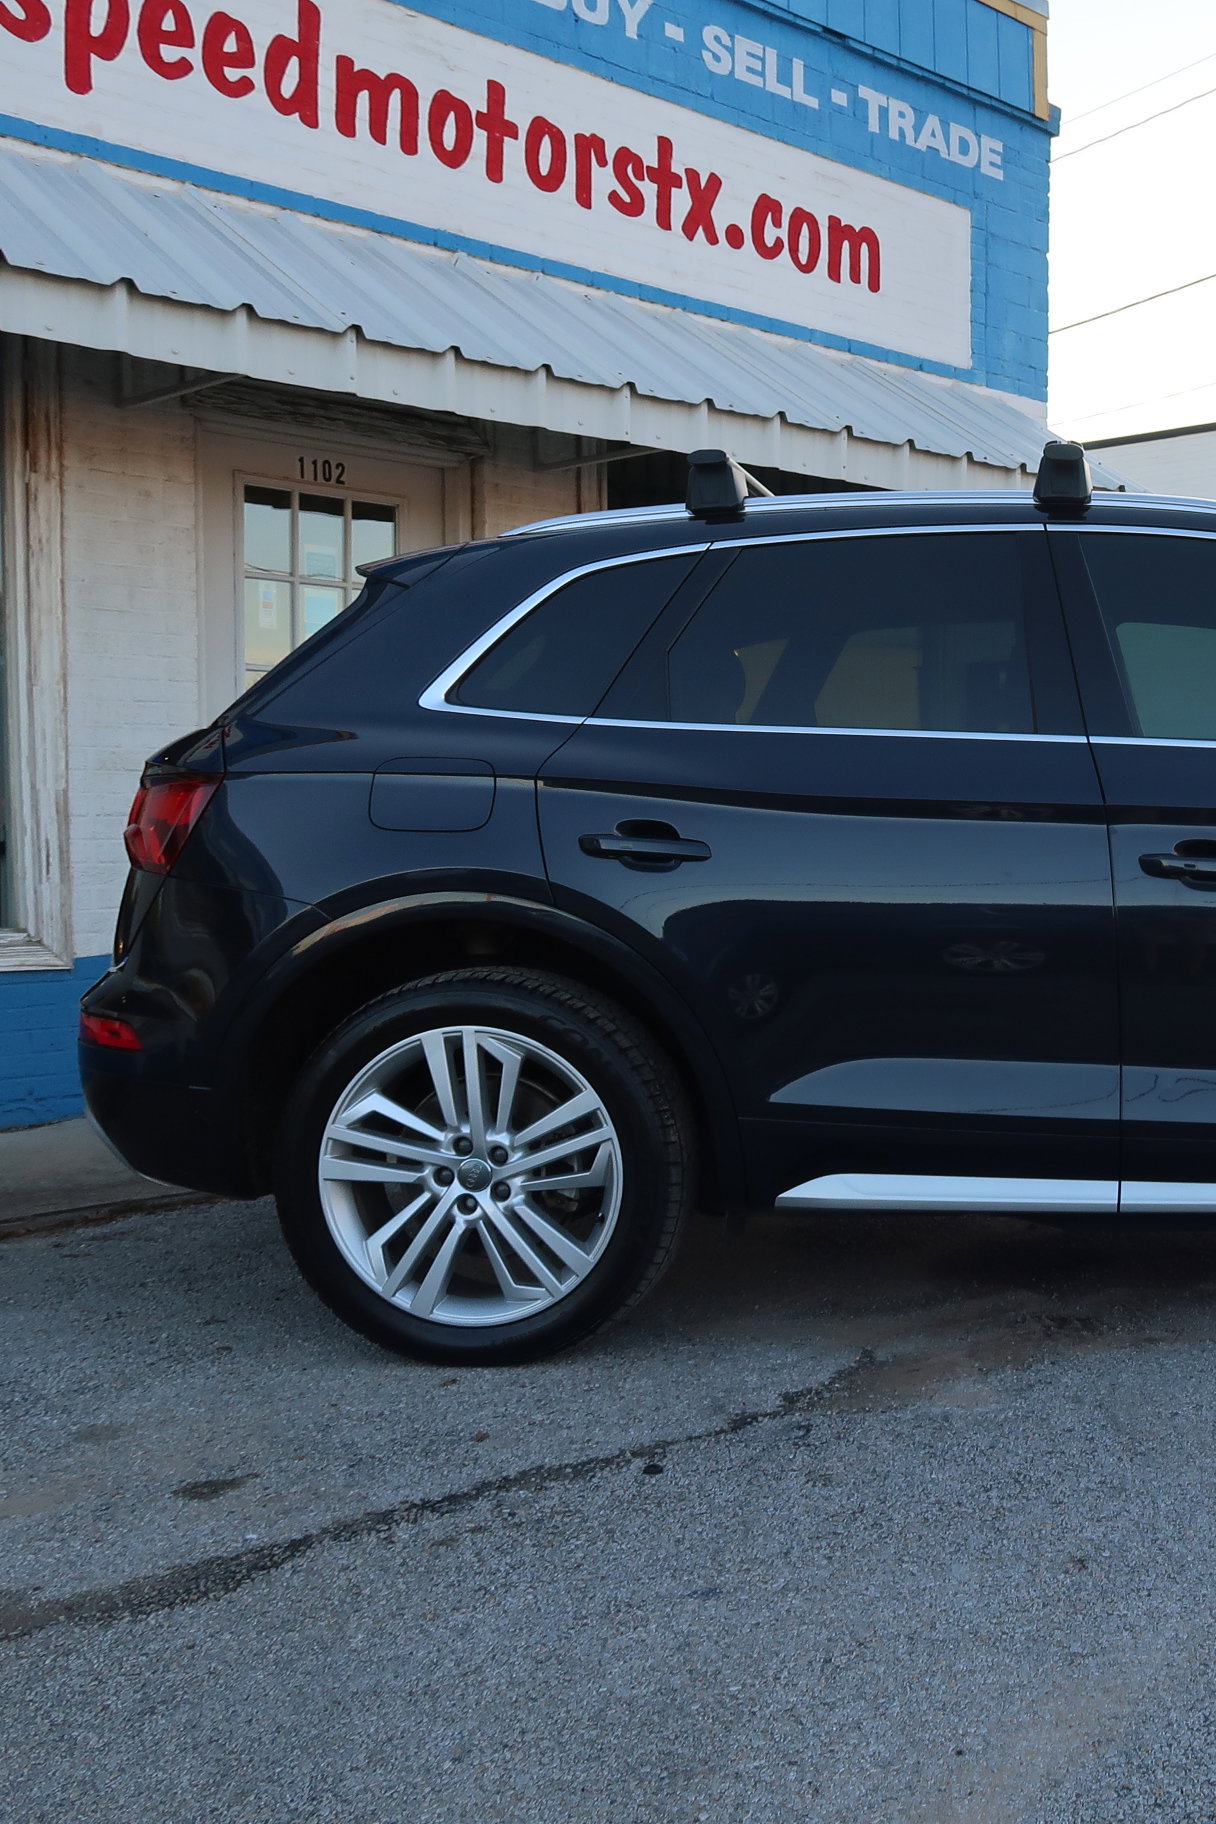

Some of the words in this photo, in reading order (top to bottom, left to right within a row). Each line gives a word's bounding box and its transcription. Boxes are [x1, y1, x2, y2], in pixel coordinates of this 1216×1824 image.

[532, 0, 650, 40] UY
[701, 24, 819, 110] SELL
[858, 85, 1004, 181] TRADE
[298, 456, 346, 485] 1102
